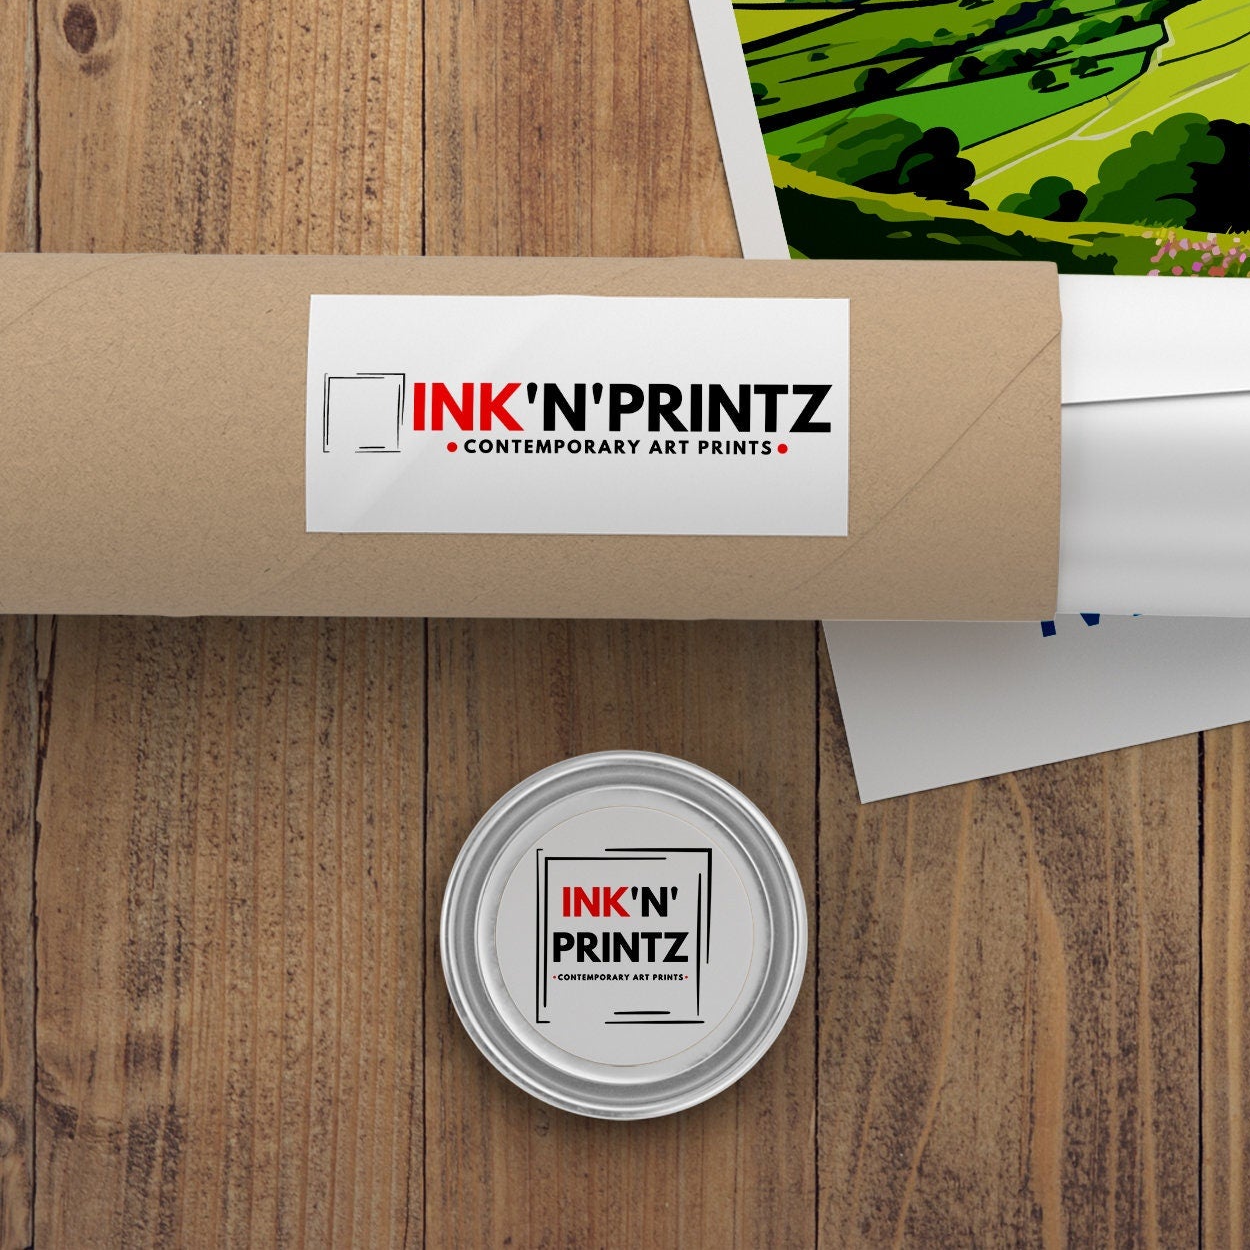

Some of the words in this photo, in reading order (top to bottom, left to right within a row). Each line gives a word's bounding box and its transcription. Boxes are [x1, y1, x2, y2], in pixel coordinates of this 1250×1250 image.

[463, 438, 640, 456] CONTEMPORARY
[648, 439, 690, 455] ART
[698, 440, 773, 456] PRINTS
[562, 885, 679, 918] INK'N'
[552, 931, 690, 963] PRINTZ
[557, 973, 630, 982] CONTEMPORARY
[632, 973, 650, 981] ART
[652, 973, 684, 981] PRINTS
